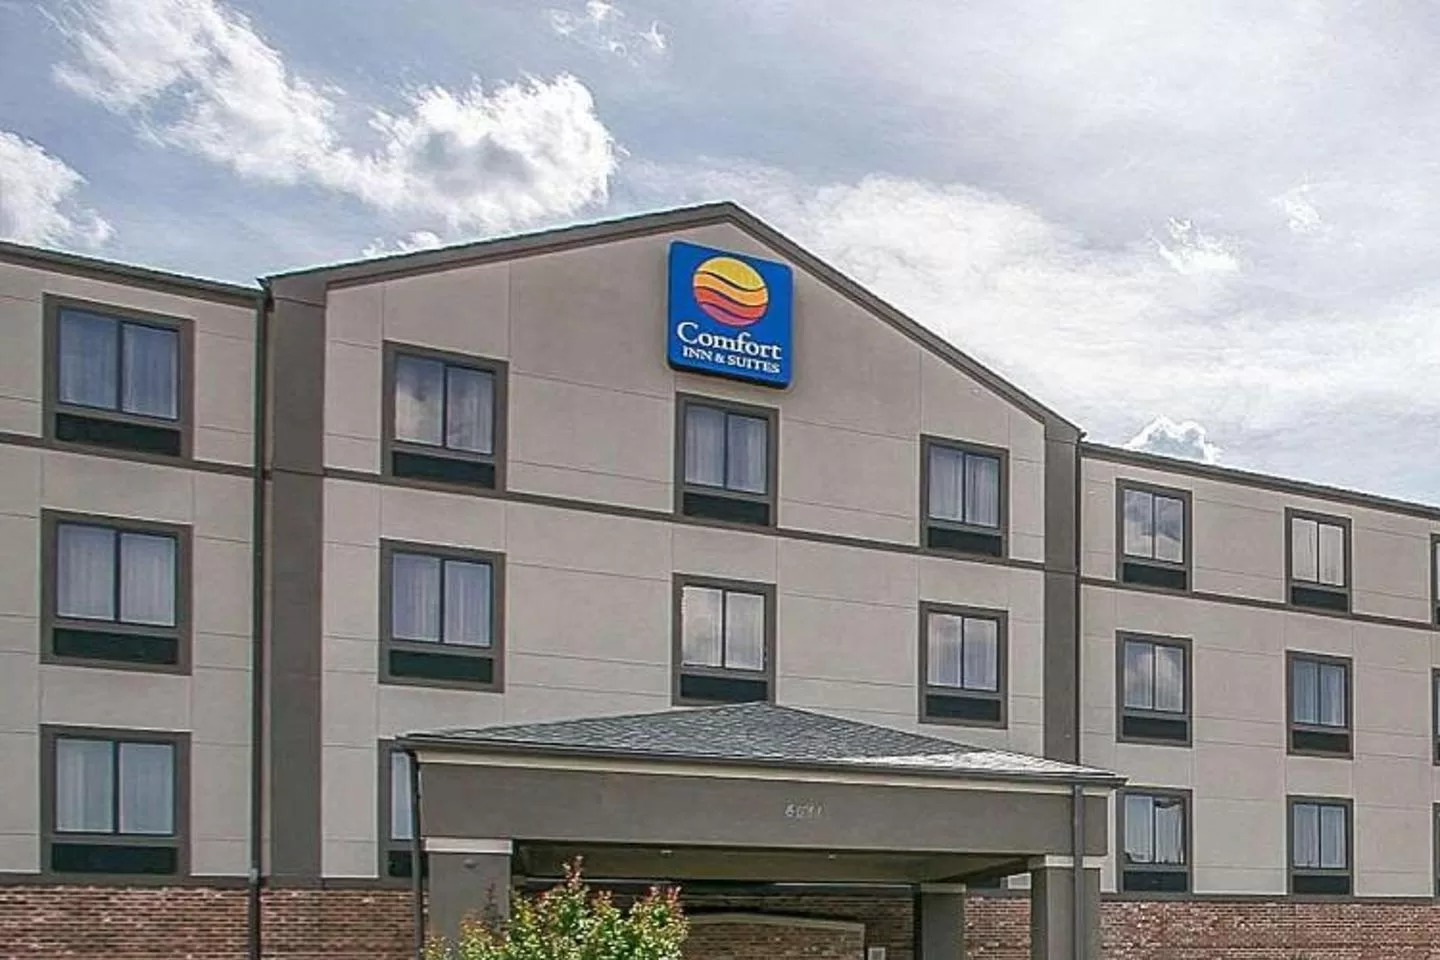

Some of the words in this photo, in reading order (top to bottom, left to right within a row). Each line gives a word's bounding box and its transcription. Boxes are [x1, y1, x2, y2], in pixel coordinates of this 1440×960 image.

[677, 321, 782, 360] Comfort
[683, 345, 714, 362] INN
[715, 353, 726, 364] &
[727, 354, 781, 374] SUITES
